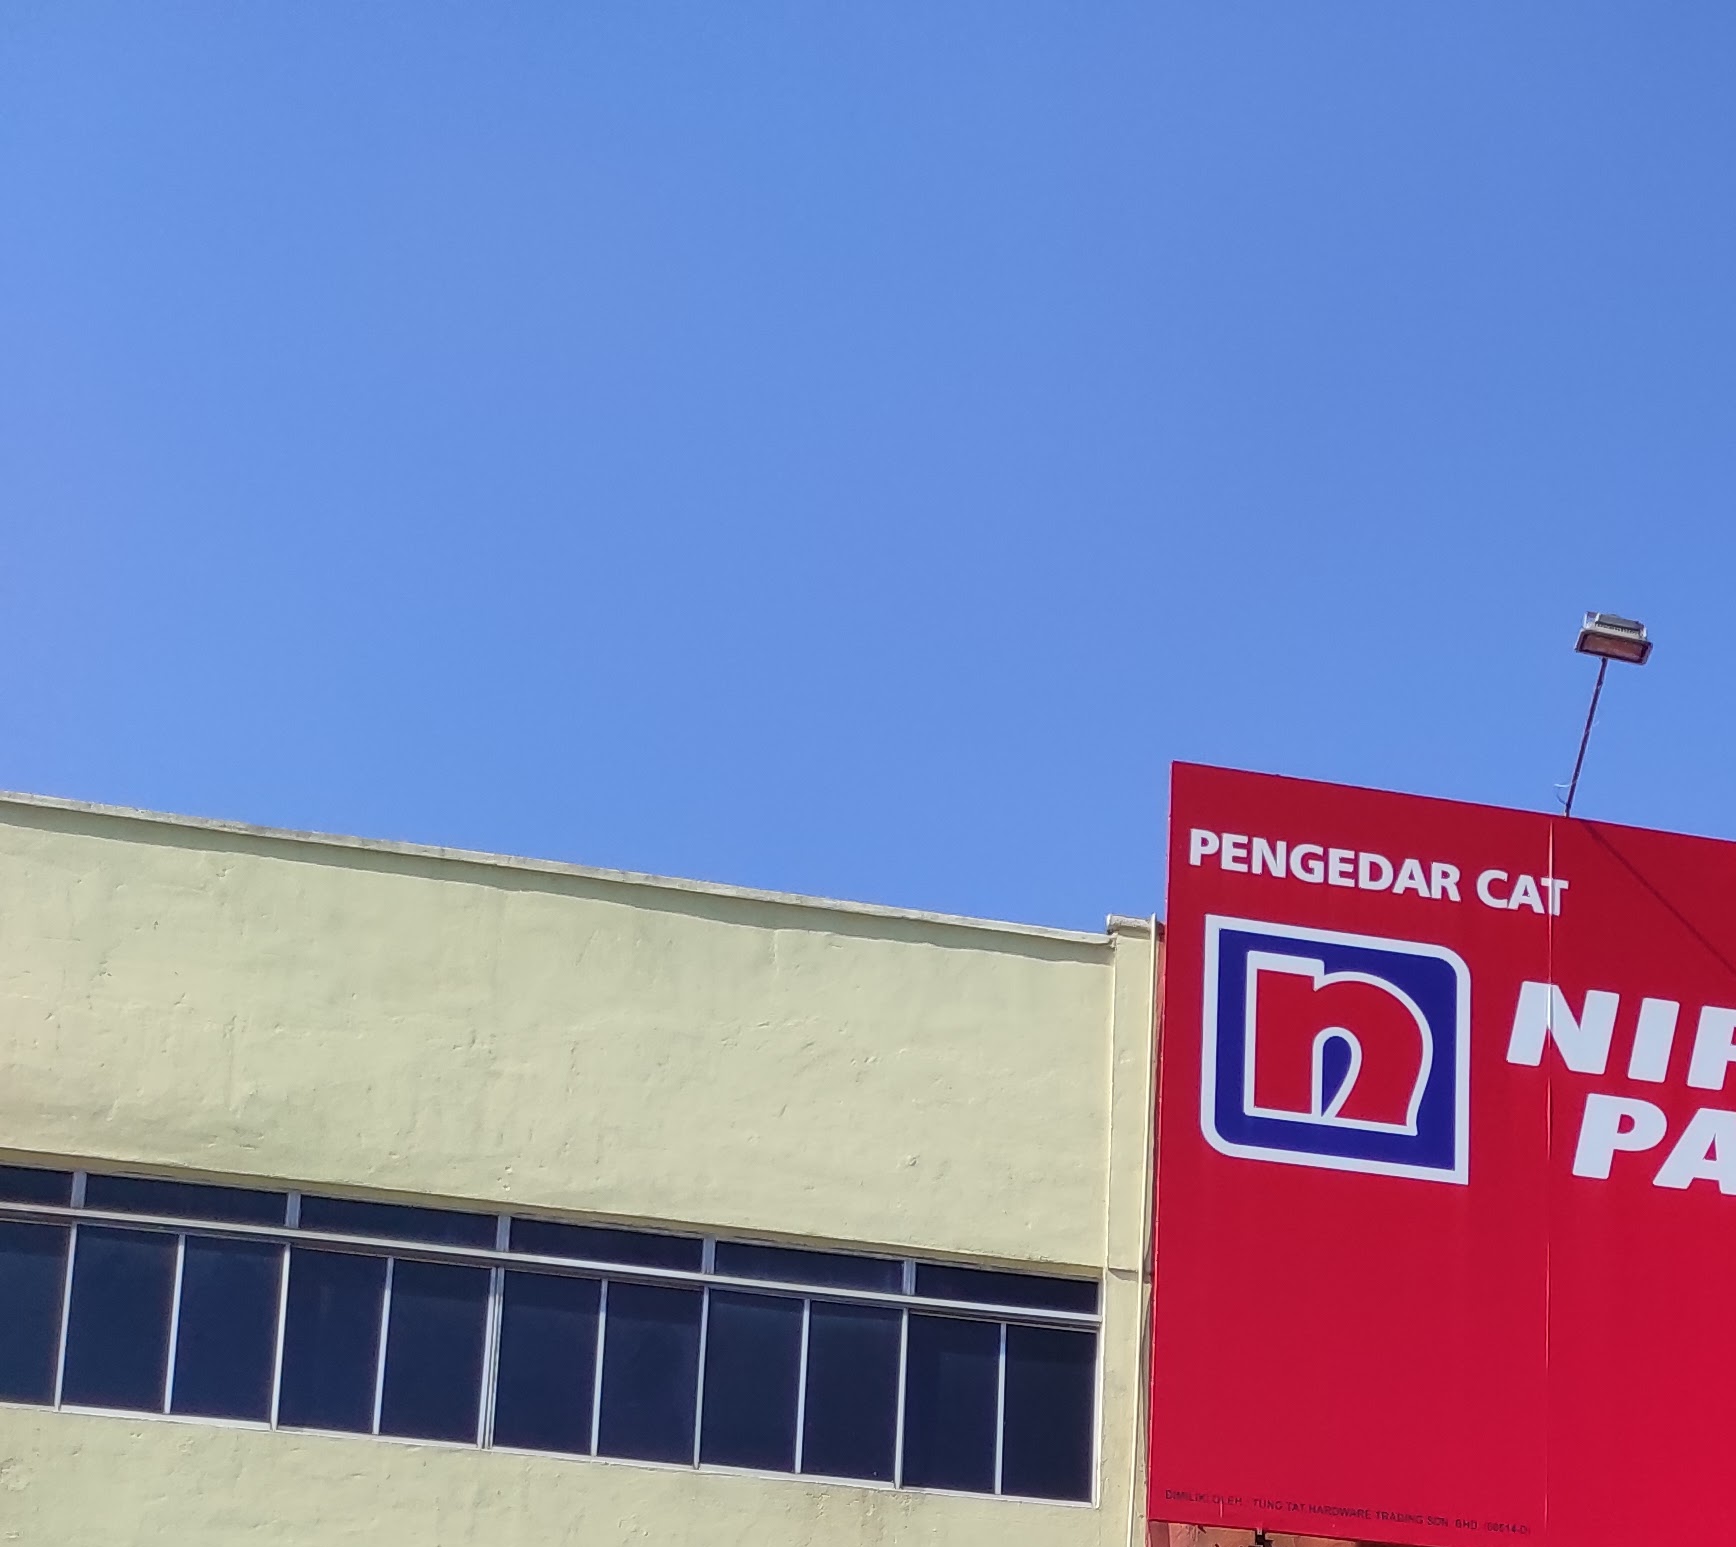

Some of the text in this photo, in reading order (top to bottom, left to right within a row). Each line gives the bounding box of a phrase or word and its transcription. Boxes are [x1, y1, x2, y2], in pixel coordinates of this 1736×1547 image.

[1187, 826, 1569, 917] PENGEDAR CAT
[1286, 1502, 1305, 1513] TAT
[1308, 1504, 1372, 1521] HARDWARE
